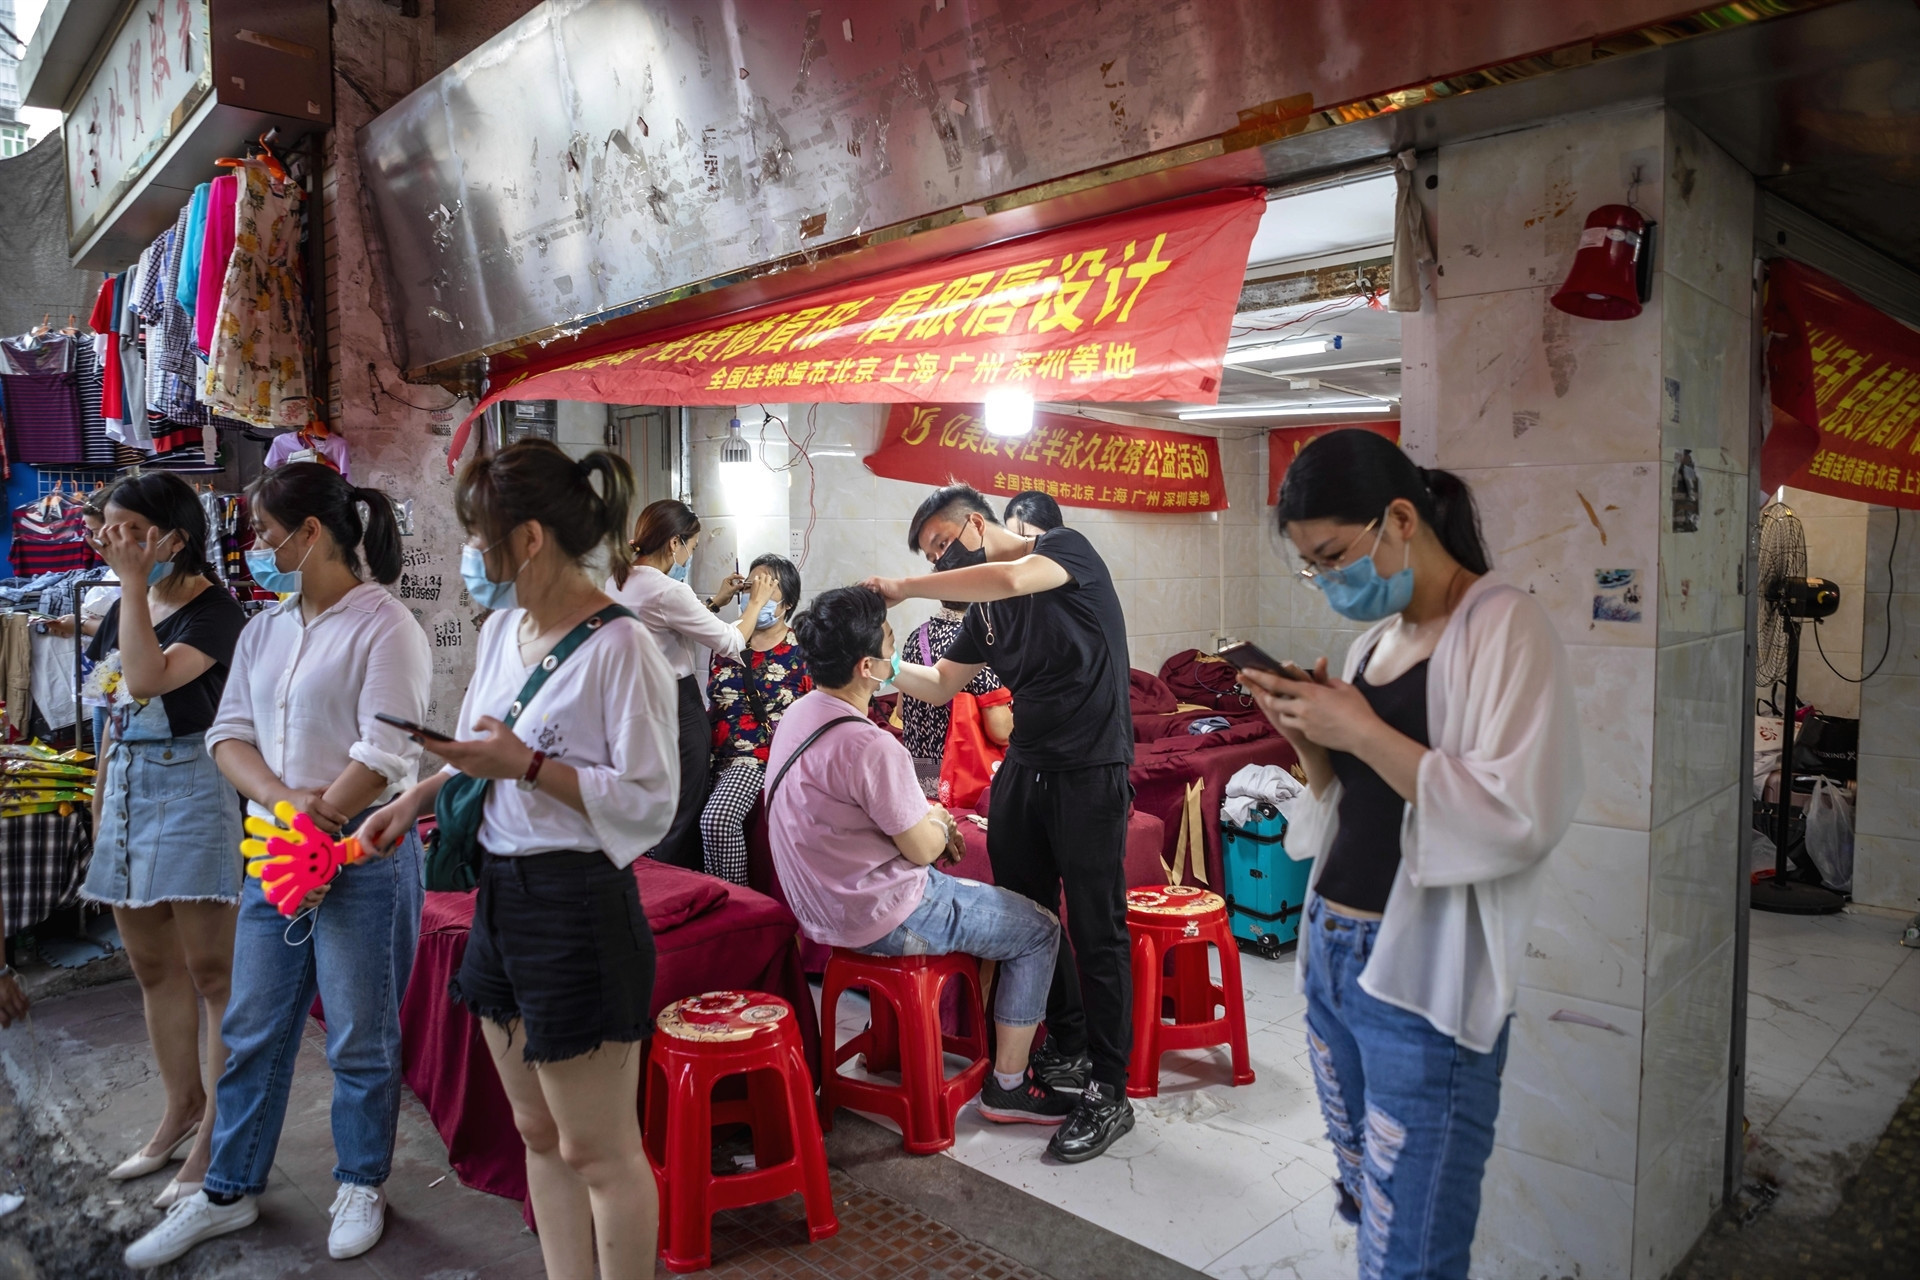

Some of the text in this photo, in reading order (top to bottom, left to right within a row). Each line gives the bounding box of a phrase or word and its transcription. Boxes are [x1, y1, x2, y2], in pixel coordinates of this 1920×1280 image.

[857, 232, 1171, 344] 眉眼唇设计
[705, 342, 1137, 391] 全国连锁遍布北京 上海 广州 深圳等地
[994, 471, 1211, 507] 全国连锁遍布北京 上海 广州 深圳等地
[1901, 468, 1920, 495] 上
[436, 634, 462, 647] 51191
